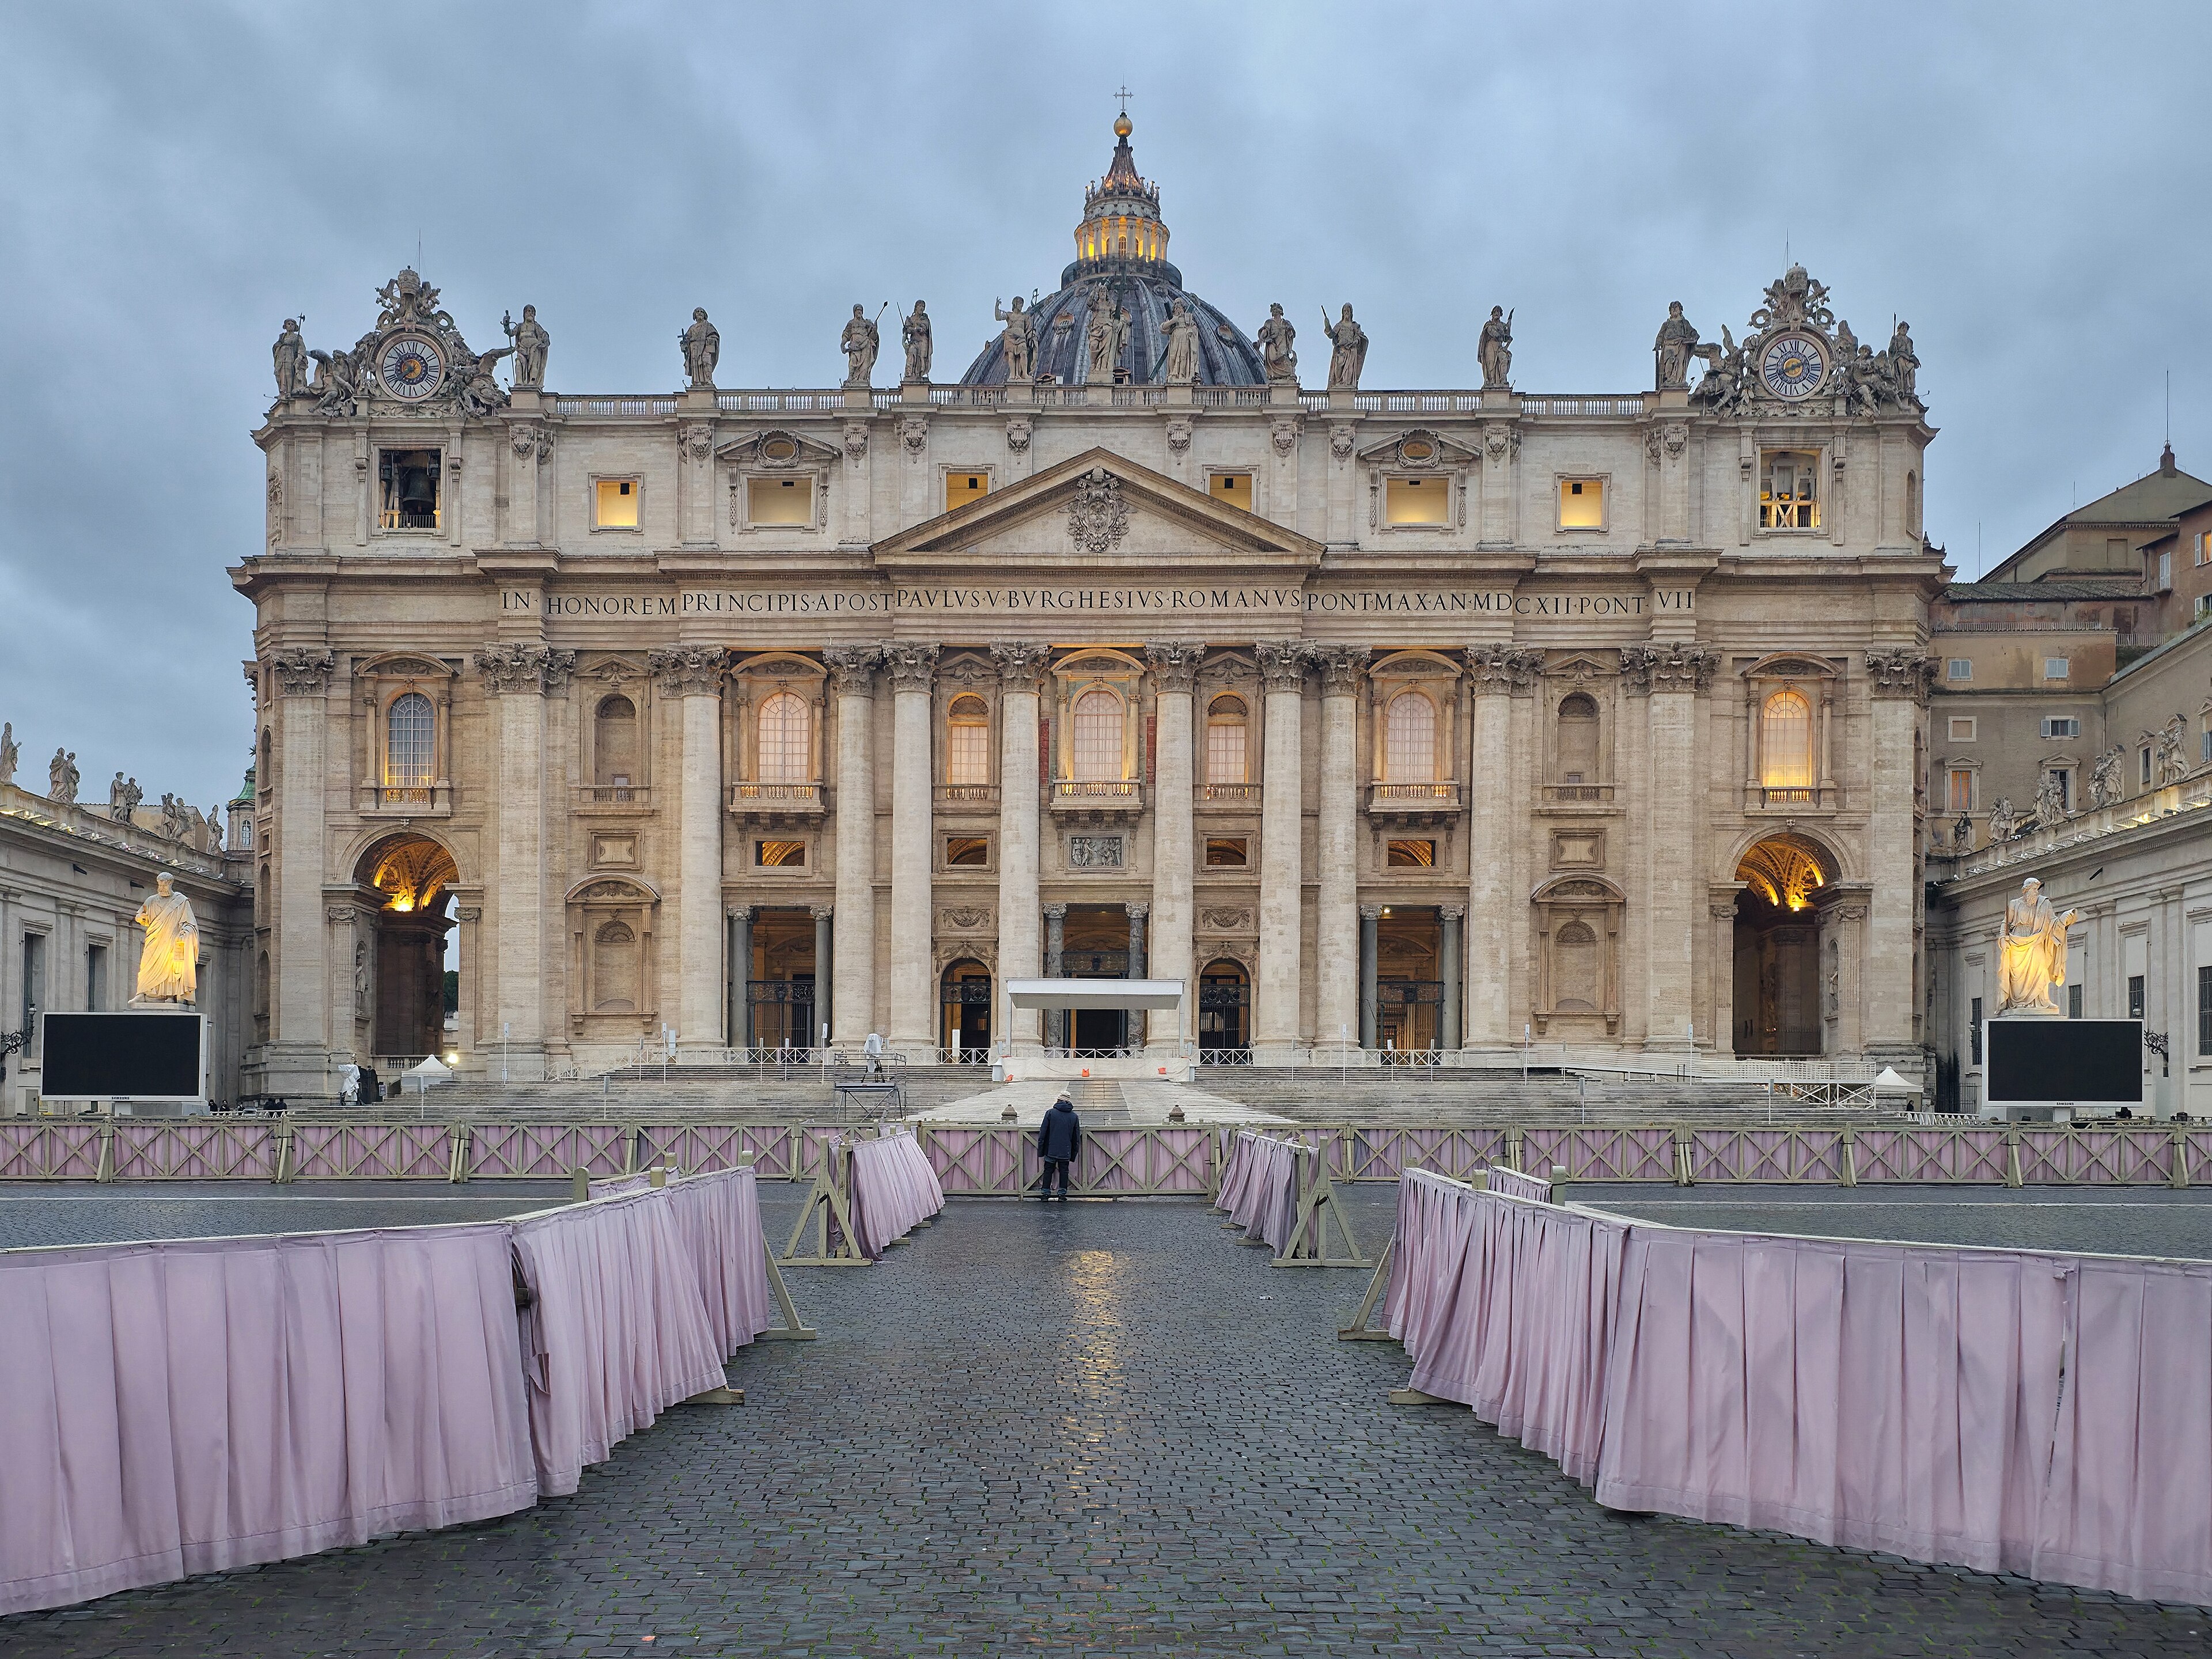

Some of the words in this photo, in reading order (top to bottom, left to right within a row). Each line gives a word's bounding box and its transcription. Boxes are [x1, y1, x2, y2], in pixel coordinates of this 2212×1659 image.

[407, 342, 418, 353] XII
[420, 346, 426, 354] I
[1789, 341, 1799, 351] XII
[1802, 344, 1808, 353] I
[426, 353, 436, 362] II
[1808, 351, 1817, 361] II
[502, 592, 530, 609] IN
[548, 597, 676, 615] HONOREM
[682, 593, 809, 612] PRINCIPIS
[815, 593, 893, 611] APOST
[896, 590, 980, 608] PAVLVS
[986, 590, 1001, 608] V
[1008, 590, 1163, 608] BVRGHESIVS
[1172, 590, 1300, 608] ROMANVS
[1307, 593, 1372, 611] PONT
[1375, 593, 1429, 611] MAX
[1432, 593, 1467, 611] AN
[1579, 597, 1646, 615] PONT
[1657, 591, 1693, 609] VII
